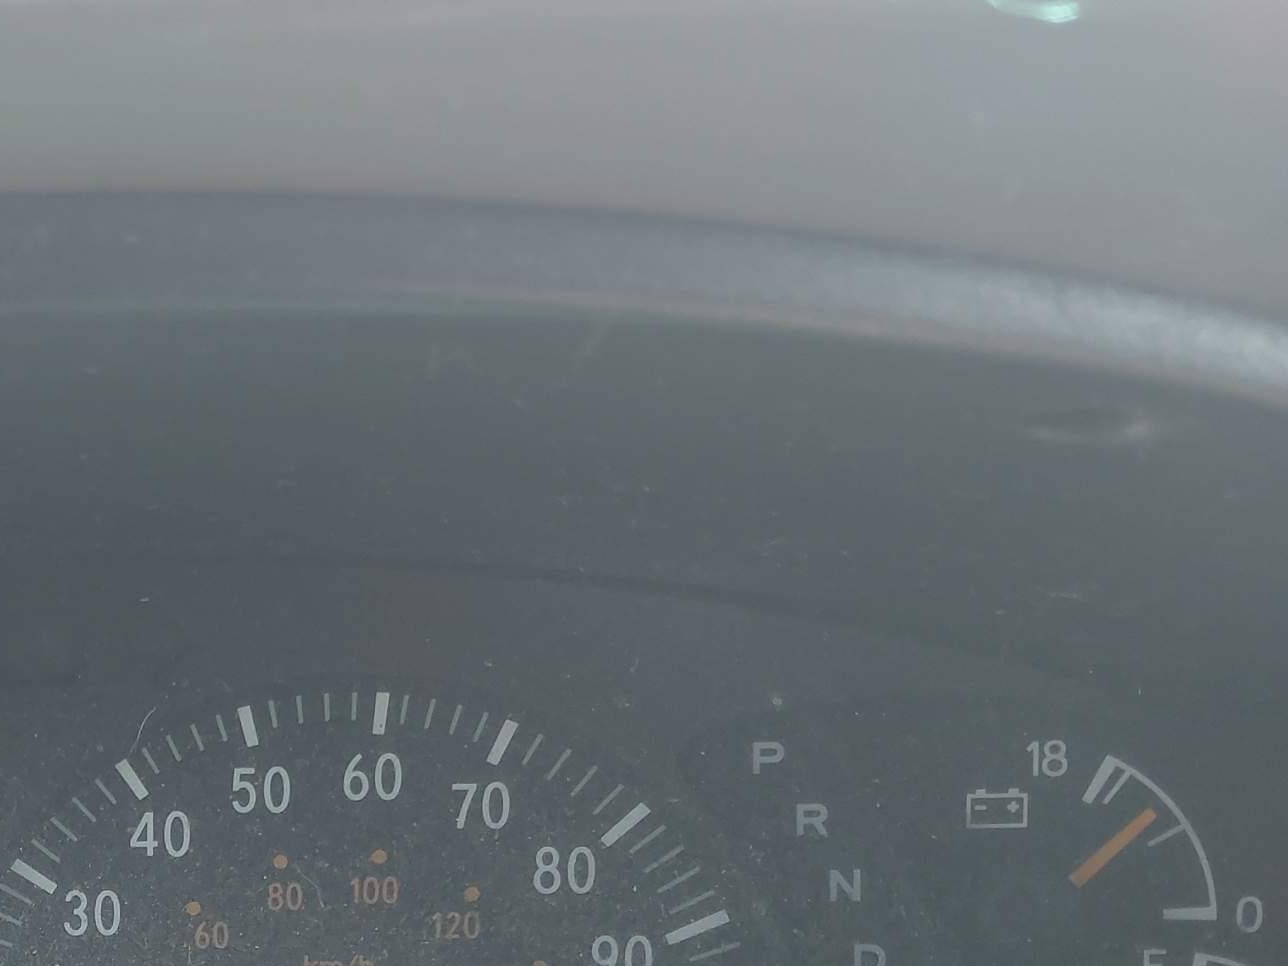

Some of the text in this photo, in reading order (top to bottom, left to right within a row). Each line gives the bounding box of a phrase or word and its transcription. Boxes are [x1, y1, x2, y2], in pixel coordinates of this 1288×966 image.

[342, 753, 403, 801] 60
[752, 742, 785, 775] P
[1026, 740, 1068, 777] 18
[230, 766, 291, 814] 50
[451, 781, 511, 829] 70
[129, 810, 191, 858] 40
[796, 803, 829, 837] R
[532, 846, 596, 894] 80
[829, 869, 862, 902] N
[267, 881, 304, 911] 80
[350, 876, 400, 905] 100
[63, 889, 122, 937] 30
[431, 911, 481, 940] 120
[1236, 896, 1264, 933] 0
[194, 921, 229, 949] 60
